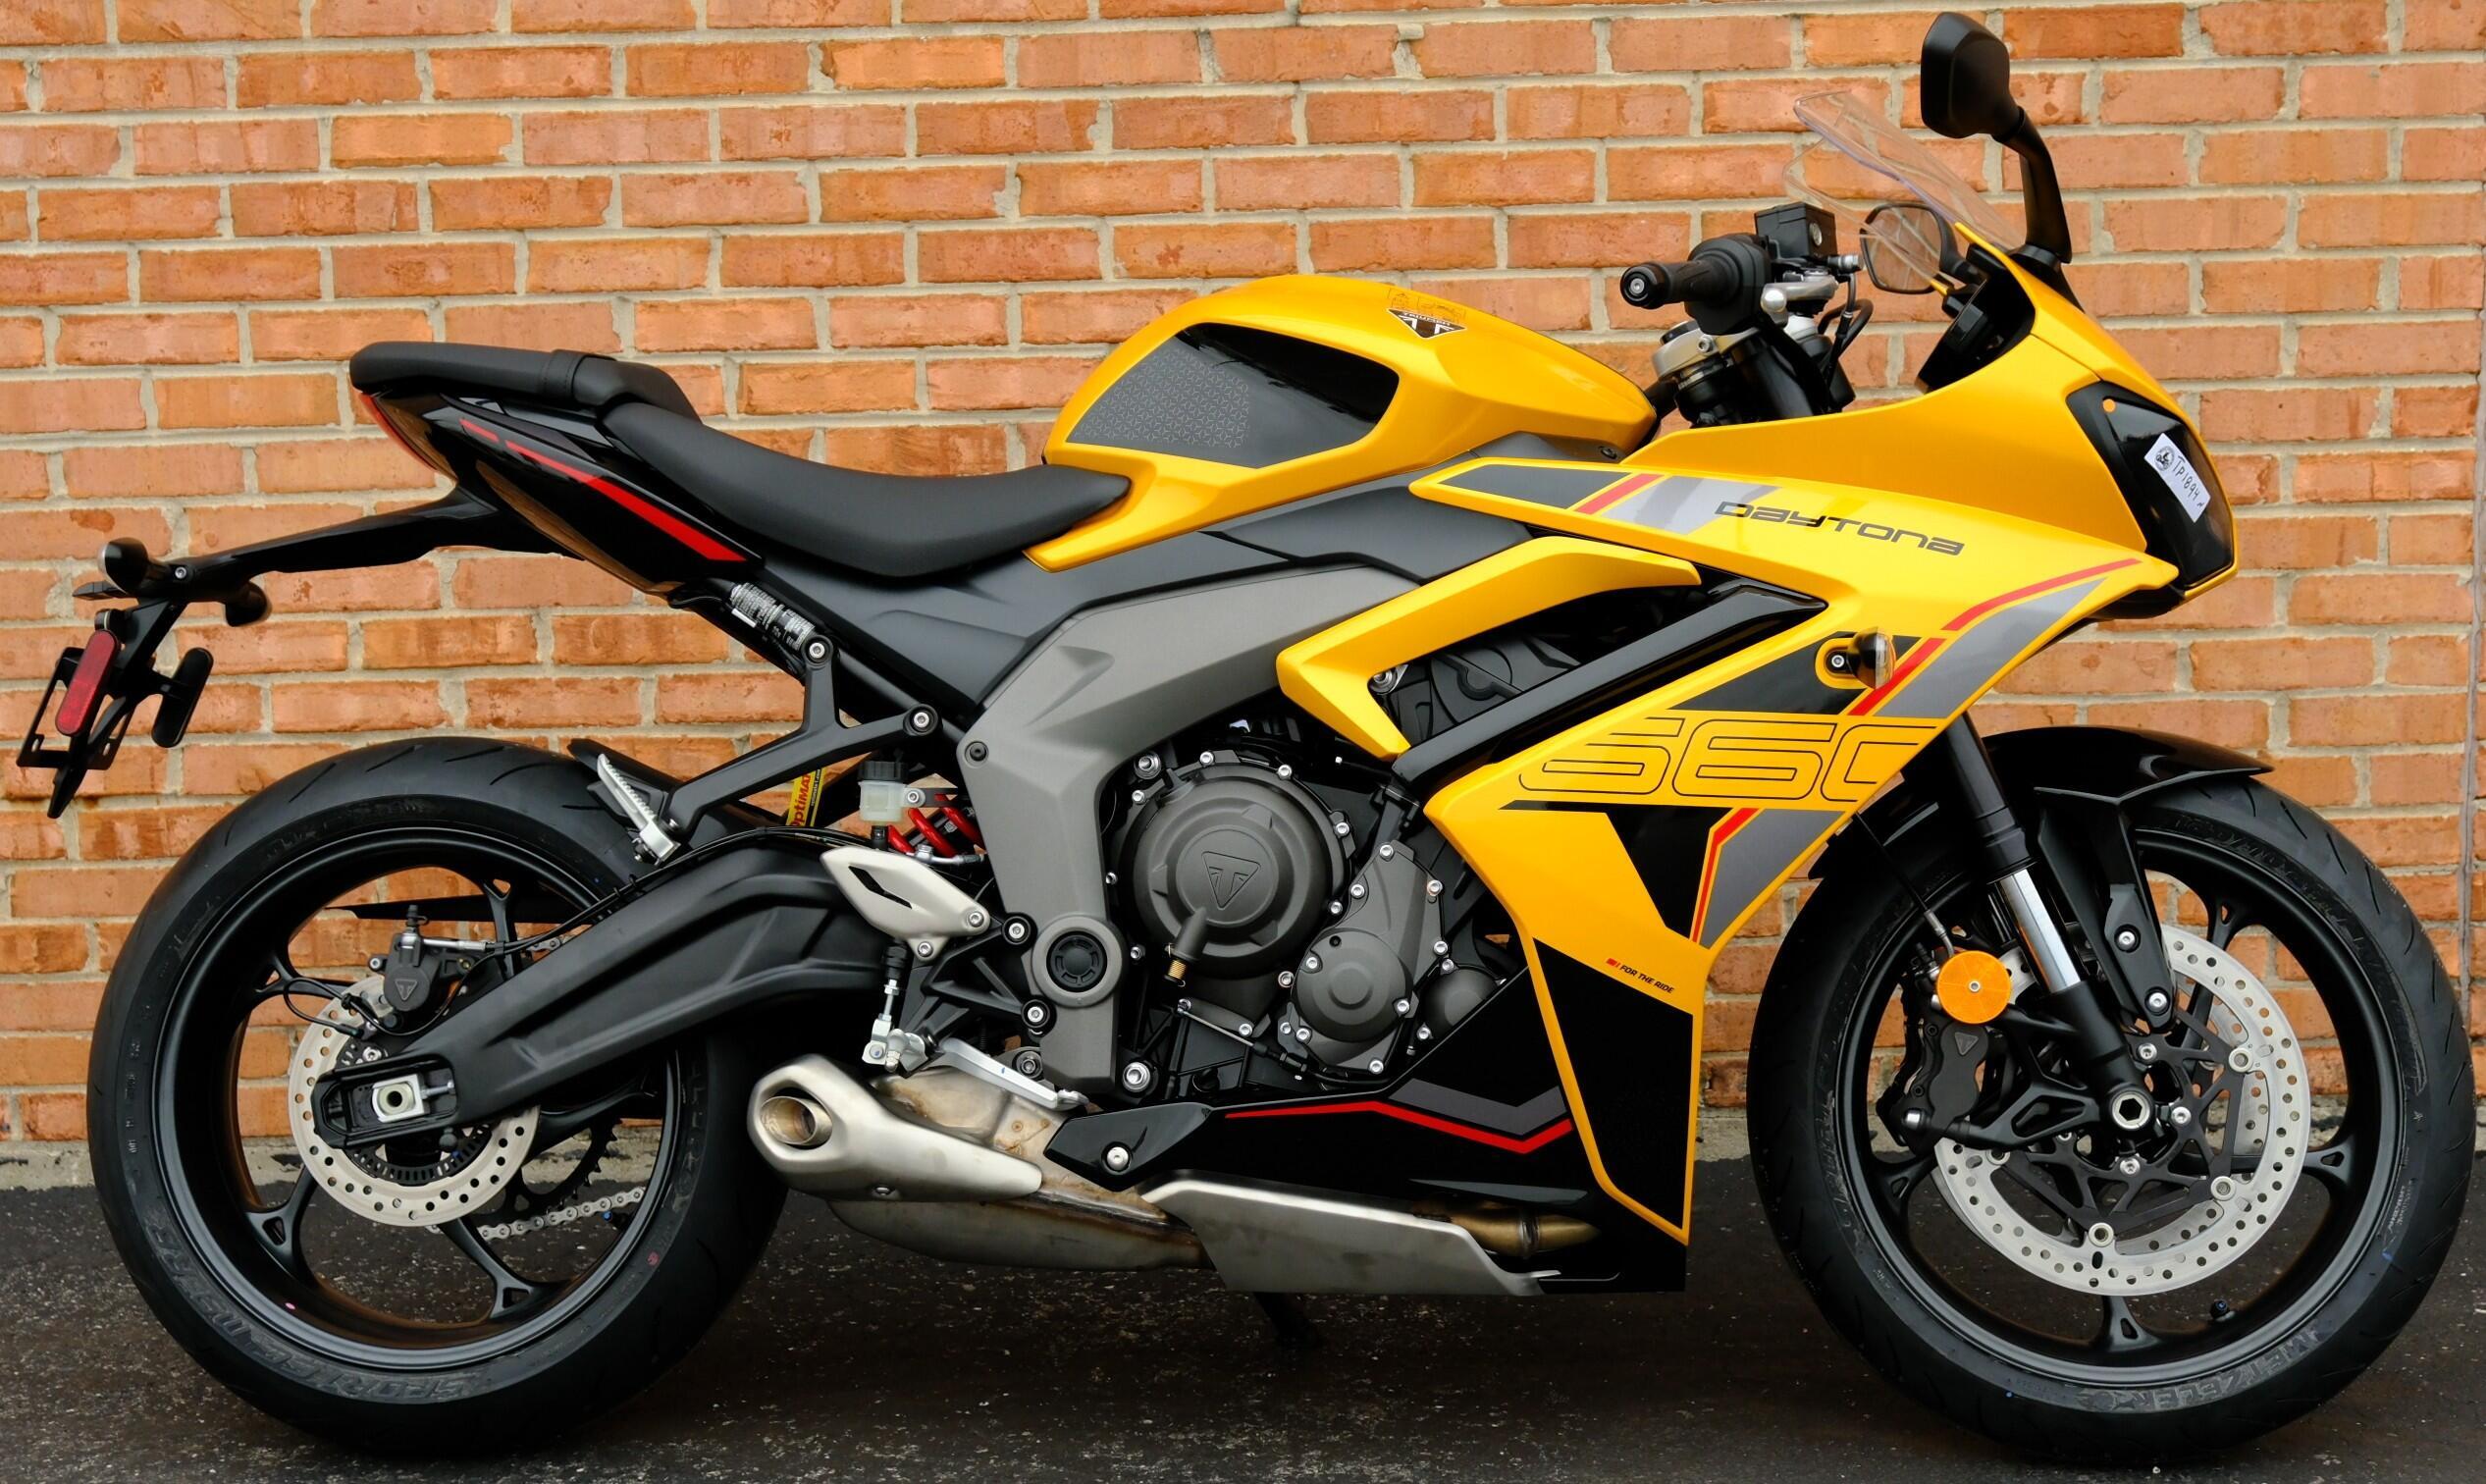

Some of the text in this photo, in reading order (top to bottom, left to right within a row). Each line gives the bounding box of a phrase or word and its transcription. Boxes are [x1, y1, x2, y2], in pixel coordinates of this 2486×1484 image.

[1620, 965, 1674, 994] FOR THE RIDE
